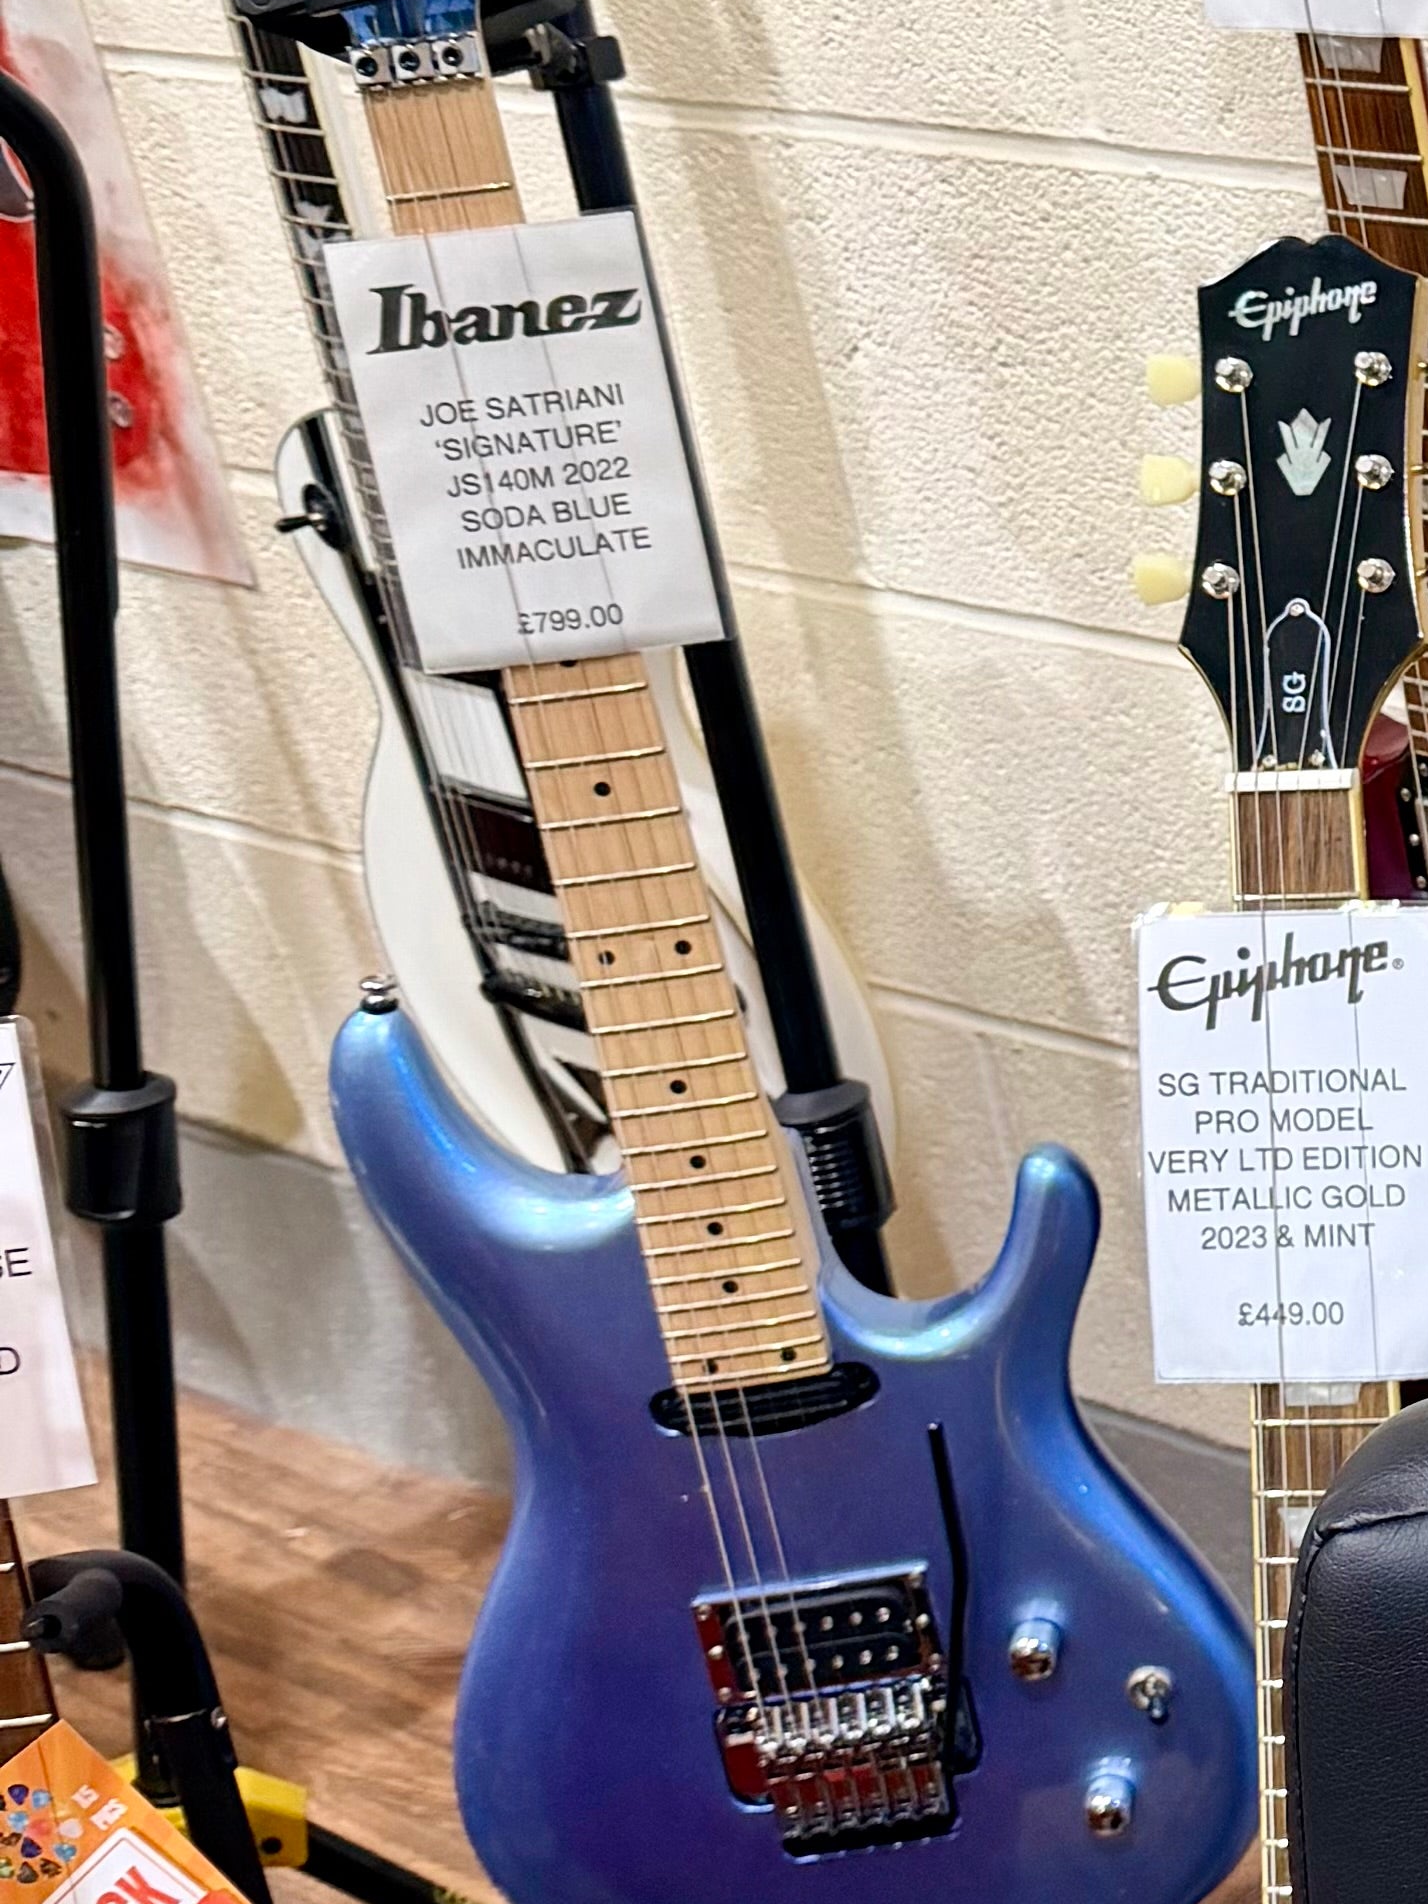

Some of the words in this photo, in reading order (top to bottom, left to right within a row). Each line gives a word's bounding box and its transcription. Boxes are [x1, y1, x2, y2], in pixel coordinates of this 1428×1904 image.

[365, 283, 641, 356] Ibanez
[1228, 277, 1378, 341] Epiphone
[419, 397, 479, 428] JOE
[485, 383, 625, 423] SATRIANI
[446, 466, 557, 499] JS140M
[562, 457, 632, 489] 2022
[460, 501, 547, 535] SODA
[553, 492, 633, 525] BLUE
[456, 526, 653, 571] IMMACULATE
[517, 603, 624, 637] £799.00
[1282, 672, 1306, 714] SG
[1146, 932, 1388, 1031] Epiphone
[1157, 1072, 1200, 1097] SG
[1210, 1069, 1407, 1096] TRADITIONAL
[1195, 1109, 1260, 1134] PRO
[1271, 1107, 1374, 1133] MODEL
[1148, 1149, 1230, 1175] VERY
[1239, 1147, 1293, 1173] LTD
[1303, 1144, 1422, 1171] EDITION
[1168, 1185, 1313, 1213] METALLIC
[1321, 1183, 1406, 1209] GOLD
[1201, 1226, 1268, 1251] 2023
[1276, 1226, 1295, 1249] &
[1304, 1223, 1376, 1248] MINT
[1237, 1301, 1345, 1328] £449.00
